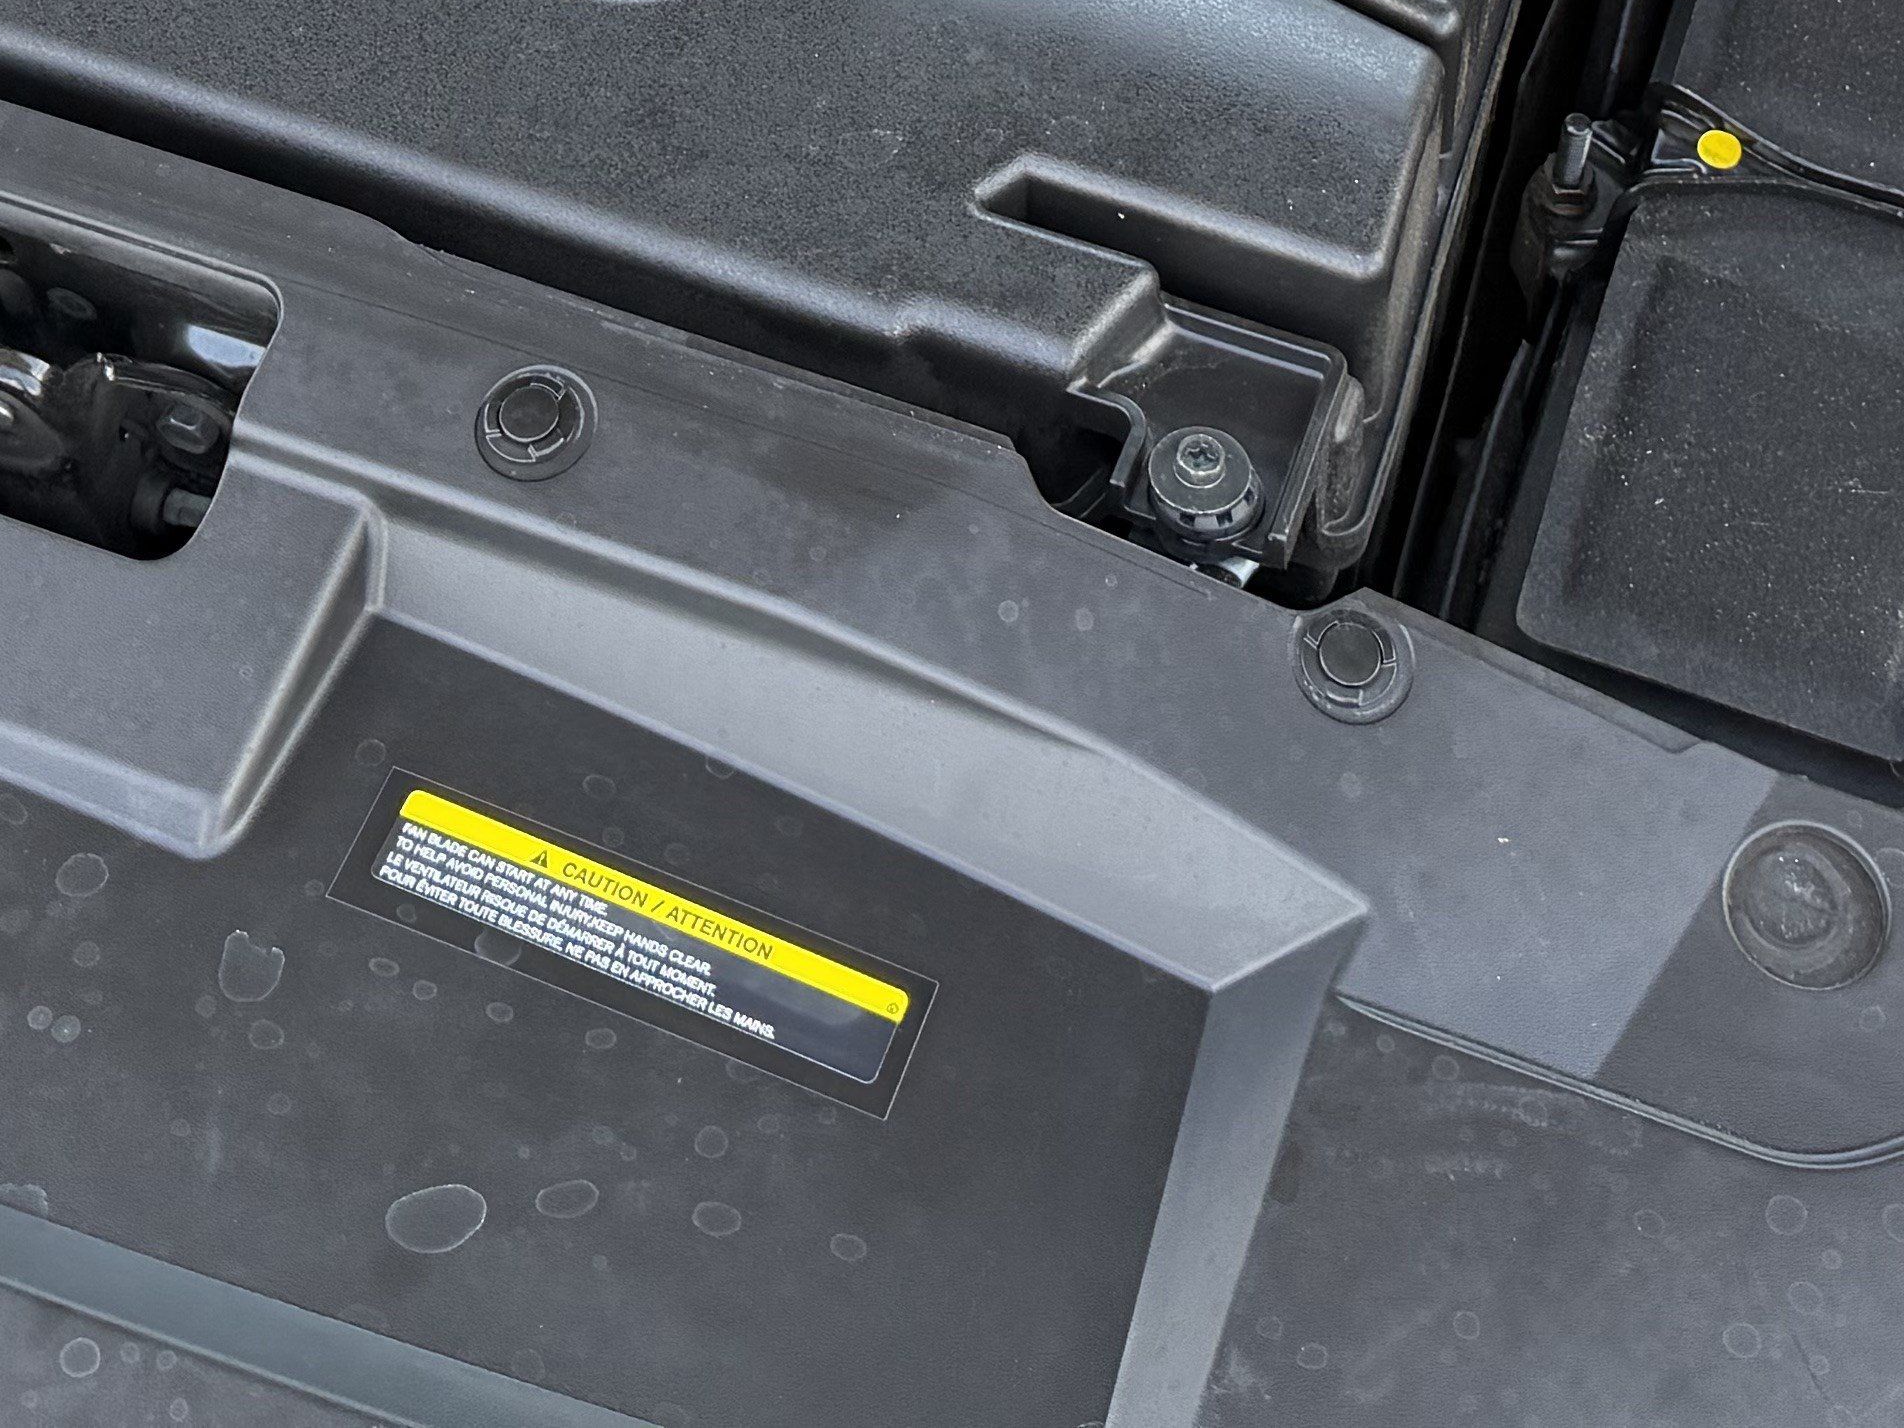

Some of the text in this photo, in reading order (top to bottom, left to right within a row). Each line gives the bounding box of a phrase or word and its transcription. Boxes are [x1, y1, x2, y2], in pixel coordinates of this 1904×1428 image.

[386, 851, 404, 866] LE
[405, 858, 480, 897] VENTILATEUR
[480, 889, 527, 917] RISQUE
[527, 909, 547, 925] DE
[546, 917, 614, 953] DÉMARRER
[627, 949, 660, 971] TOUT
[396, 835, 413, 851] TO
[413, 843, 446, 862] HELP
[445, 857, 483, 879] AVOID
[484, 872, 546, 907] PERSONAL
[623, 930, 668, 957] HANDS
[402, 822, 427, 840] FAN
[427, 832, 467, 857] BLADE
[467, 849, 495, 869] CAN
[495, 861, 535, 883] START
[533, 877, 551, 890] AT
[549, 884, 578, 902] ANY
[562, 862, 647, 906] CAUTION
[666, 906, 772, 959] ATTENTION
[379, 865, 415, 888] POUR
[415, 878, 457, 905] ÉVITER
[458, 896, 498, 922] TOUTE
[565, 941, 584, 958] NE
[584, 949, 610, 969] PAS
[610, 960, 630, 977] EN
[629, 970, 707, 1009] APPROCHER
[707, 1001, 732, 1020] LES
